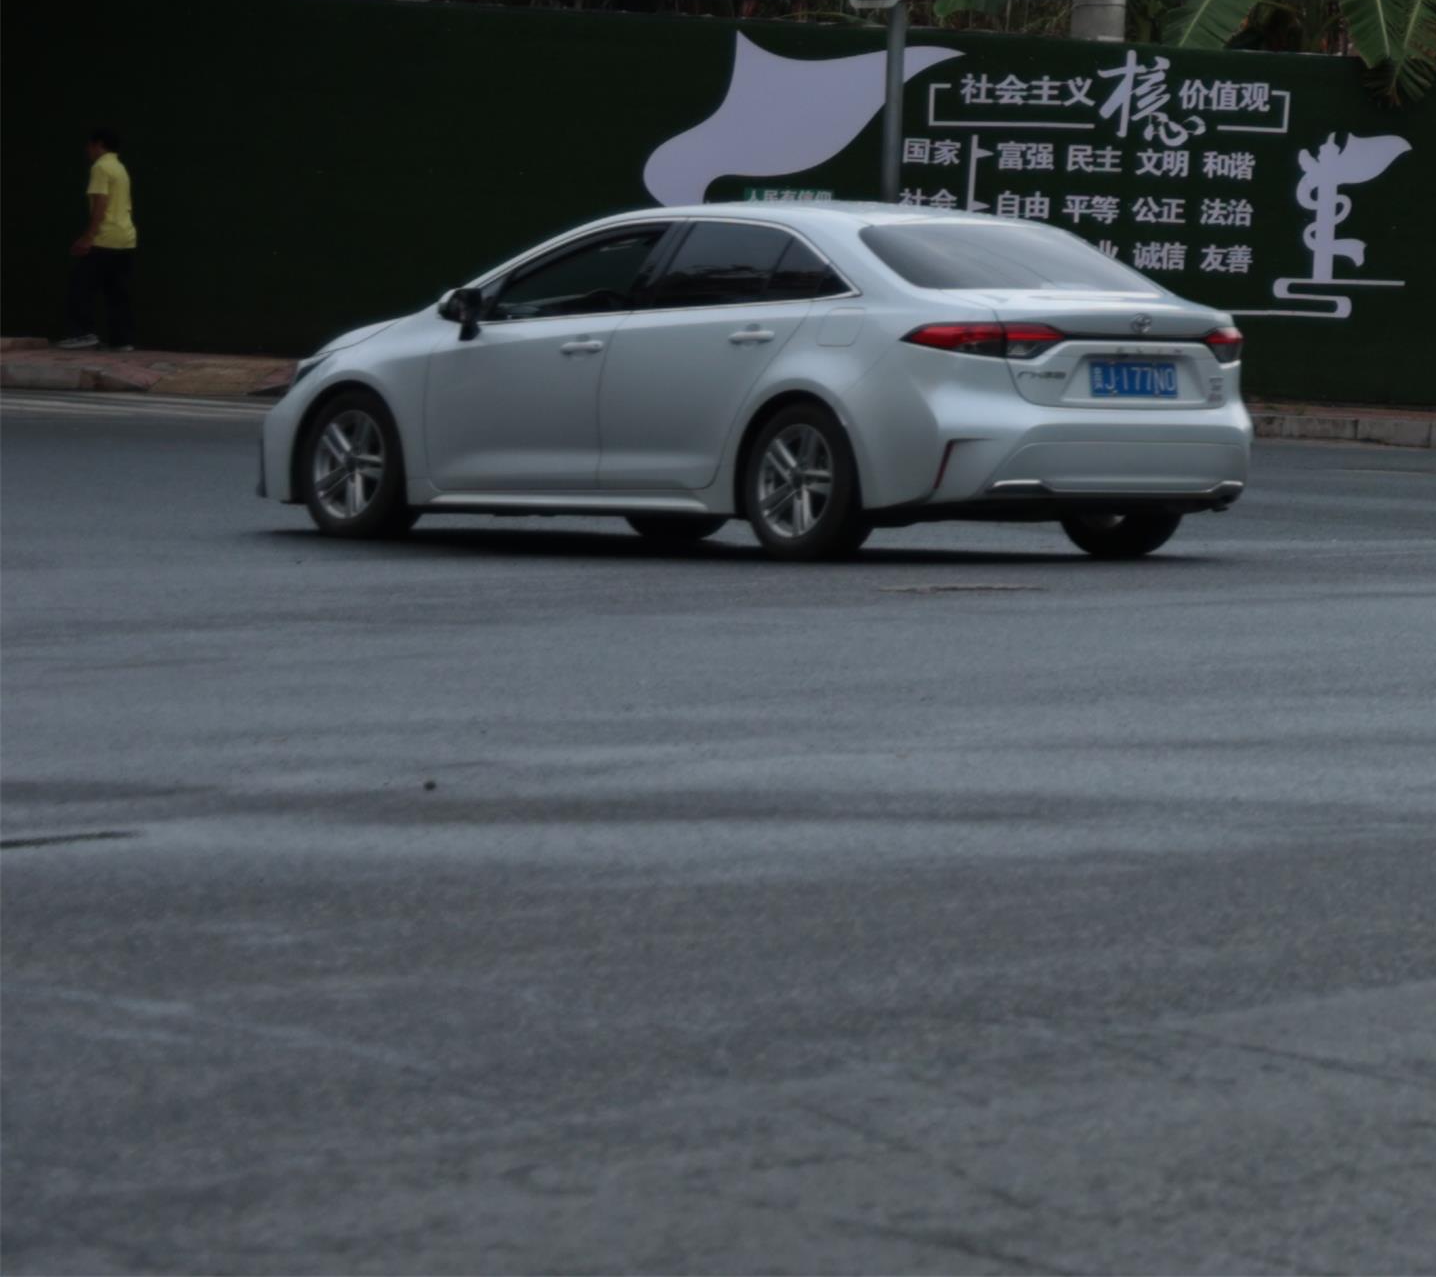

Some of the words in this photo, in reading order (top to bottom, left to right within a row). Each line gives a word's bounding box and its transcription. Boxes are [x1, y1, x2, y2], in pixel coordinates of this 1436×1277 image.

[960, 74, 1095, 109] 社会主义
[1178, 80, 1271, 113] 价值观
[901, 137, 962, 166] 国家
[996, 140, 1055, 172] 富强
[1066, 143, 1123, 174] 民主
[1135, 147, 1189, 178] 文明
[1202, 151, 1256, 181] 和谐
[899, 188, 958, 210] 社会
[995, 190, 1050, 220] 自由
[1062, 194, 1120, 224] 平等
[1132, 196, 1186, 226] 公正
[1200, 198, 1254, 227] 法治
[1133, 241, 1187, 271] 诚信
[1200, 244, 1254, 274] 友善
